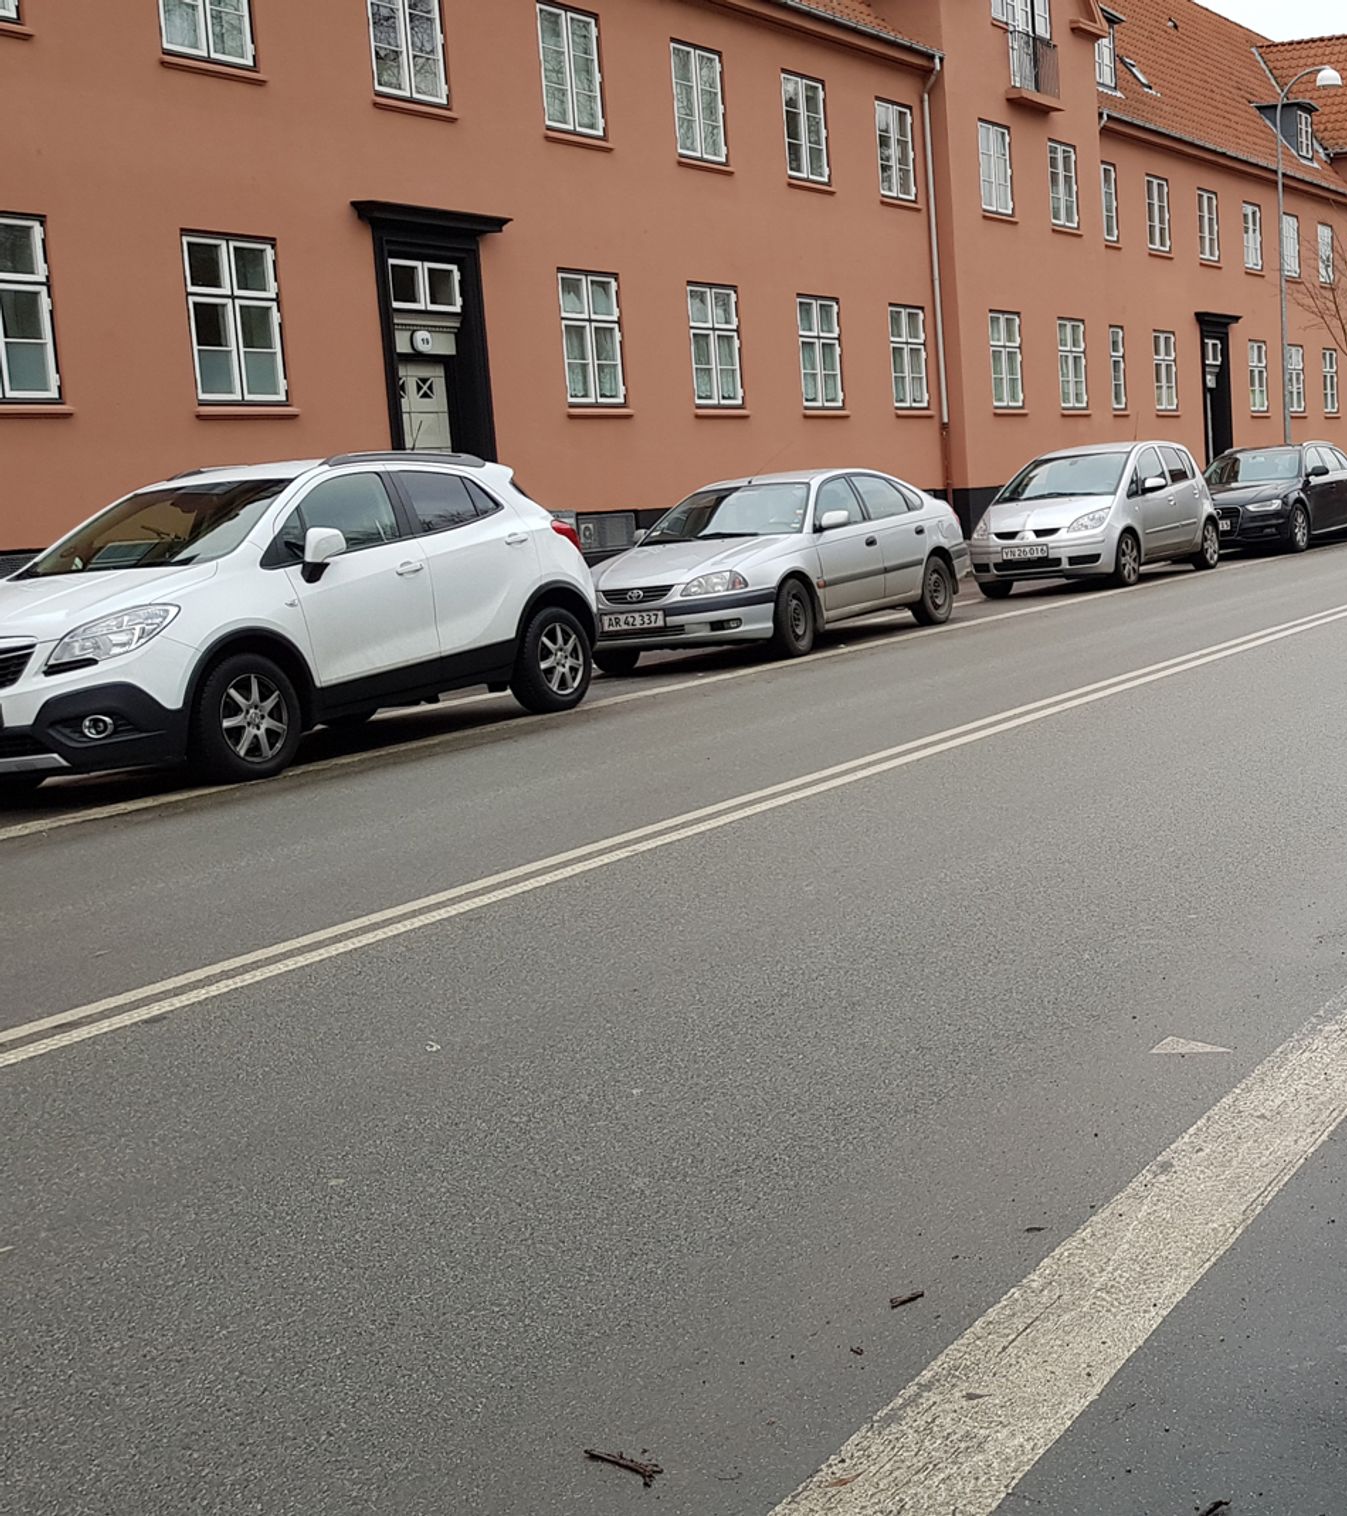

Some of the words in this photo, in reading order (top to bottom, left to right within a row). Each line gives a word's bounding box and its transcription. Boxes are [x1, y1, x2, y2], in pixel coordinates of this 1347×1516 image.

[608, 616, 622, 629] AR
[623, 615, 637, 627] 42
[638, 613, 658, 625] 337
